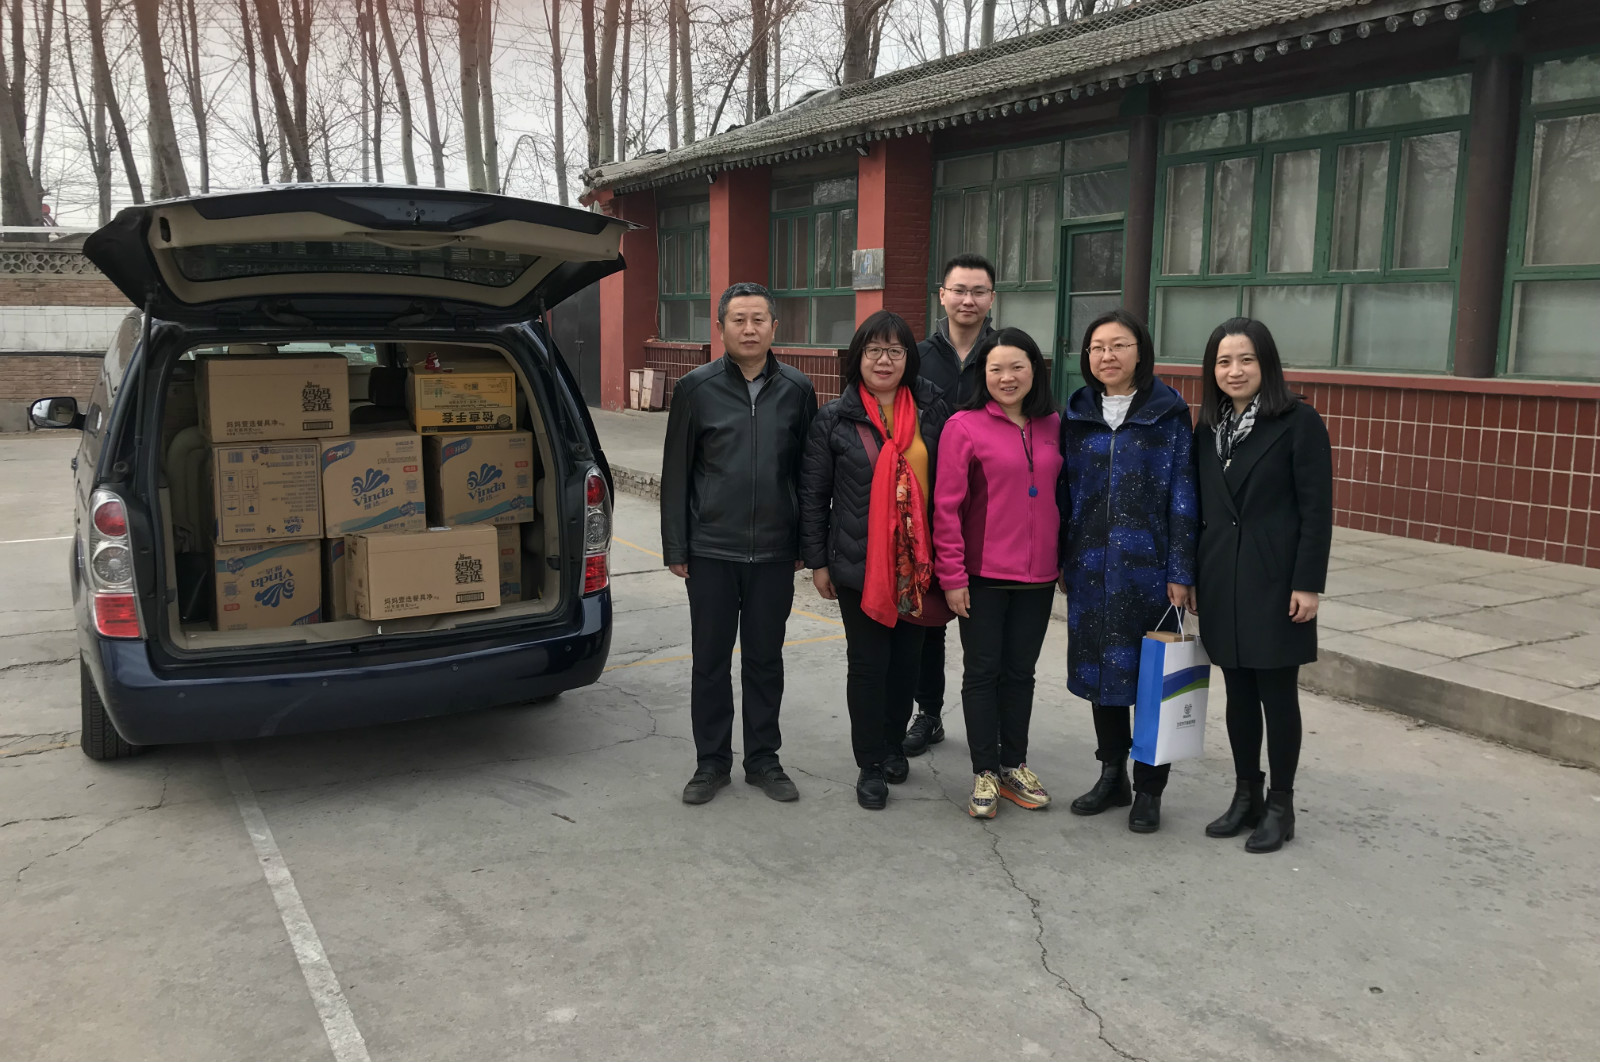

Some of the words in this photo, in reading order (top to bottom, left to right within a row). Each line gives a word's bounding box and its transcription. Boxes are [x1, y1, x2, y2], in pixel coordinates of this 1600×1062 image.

[302, 388, 331, 400] 妈妈
[302, 400, 332, 412] 壹选
[442, 411, 494, 424] 检查手套
[353, 487, 394, 506] Vinda
[467, 482, 506, 500] Vinda
[455, 559, 482, 571] 妈妈
[250, 568, 293, 588] Vinda
[455, 571, 483, 584] 壹选
